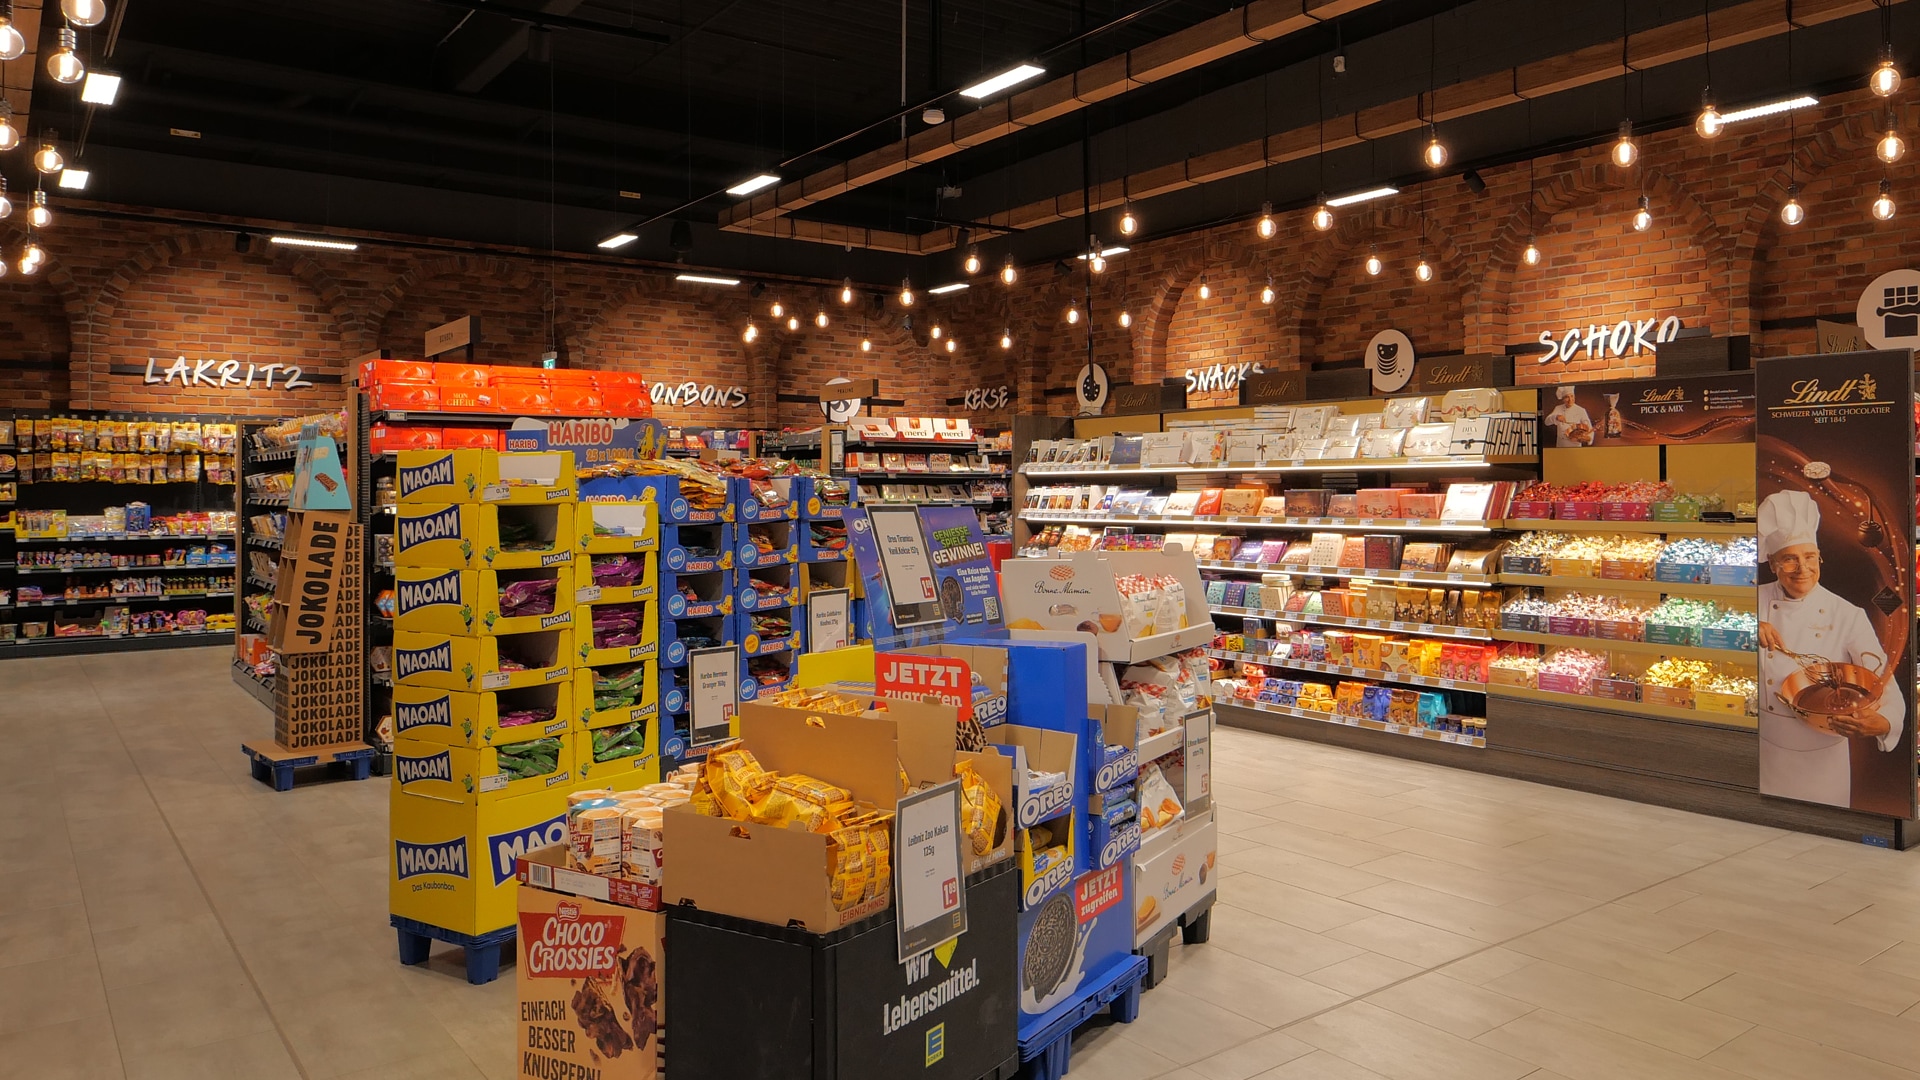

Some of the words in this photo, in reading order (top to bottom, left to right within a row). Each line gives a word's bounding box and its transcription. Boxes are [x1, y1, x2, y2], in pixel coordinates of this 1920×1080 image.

[1538, 315, 1680, 363] SCHOKO
[144, 356, 313, 390] LAKRITZ
[1426, 366, 1472, 386] Lindt
[650, 382, 747, 408] ONBONS
[1255, 381, 1290, 398] Lindt
[1640, 388, 1675, 402] Lindt
[1783, 378, 1859, 404] Lindt
[964, 385, 1009, 411] KEKSE
[1121, 393, 1149, 408] Lindt
[1640, 406, 1659, 414] PICK
[1660, 406, 1667, 414] &
[1667, 405, 1684, 413] MIX
[1771, 410, 1811, 418] SCHWEIZER
[1811, 408, 1837, 417] MAÎTRE
[1838, 406, 1890, 416] CHOCOLATIER
[1814, 416, 1828, 424] SEIT
[1830, 415, 1847, 423] 1845
[547, 421, 614, 446] HARIBO
[904, 429, 928, 437] merci
[941, 430, 964, 438] merci
[508, 439, 538, 449] HARIBO
[586, 449, 599, 462] 25
[402, 458, 451, 495] MAOAM
[547, 489, 569, 499] MAOAM
[673, 504, 686, 514] NEU
[689, 511, 716, 521] HARIBO
[745, 504, 756, 513] NEU
[760, 510, 781, 519] HARIBO
[822, 508, 842, 517] HARIBO
[401, 510, 458, 547] MAOAM
[853, 518, 871, 534] OR
[634, 538, 654, 547] MAOAM
[541, 550, 571, 566] MAOAM
[670, 553, 683, 563] NEU
[743, 549, 755, 558] NEU
[758, 555, 780, 565] HARIBO
[932, 541, 985, 565] GEWINNE!
[686, 561, 714, 571] HARIBO
[296, 521, 340, 645] JOKOLADE
[1034, 580, 1060, 595] Bonne
[1058, 581, 1092, 595] Maman
[400, 575, 457, 611] MAOAM
[632, 587, 653, 598] MAOAM
[743, 593, 755, 602] NEU
[670, 601, 683, 611] NEU
[758, 596, 782, 608] HARIBO
[687, 605, 713, 616] HARIBO
[541, 612, 571, 628] MAOAM
[630, 642, 655, 658] MAOAM
[670, 647, 683, 658] NEU
[760, 642, 785, 653] HARIBO
[291, 653, 361, 669] JOKOLADE
[398, 645, 449, 675] MAOAM
[291, 666, 361, 682] JOKOLADE
[546, 667, 568, 680] MAOAM
[883, 662, 962, 688] JETZT
[291, 679, 361, 696] JOKOLADE
[742, 685, 754, 694] NEU
[757, 686, 781, 697] HARIBO
[291, 692, 361, 708] JOKOLADE
[668, 695, 681, 706] NEU
[884, 689, 963, 708] zugrfen
[291, 704, 361, 722] JOKOLADE
[398, 700, 448, 729] MAOAM
[631, 704, 656, 719] MAOAM
[974, 696, 1007, 720] REO
[291, 717, 361, 735] JOKOLADE
[545, 721, 568, 734] MAOAM
[291, 730, 361, 748] JOKOLADE
[668, 743, 681, 754] NEU
[685, 745, 712, 759] HARIBO
[634, 754, 654, 767] MAOAM
[398, 755, 449, 783] MAOAM
[1097, 751, 1139, 790] OREO
[546, 772, 569, 786] MAOAM
[1020, 782, 1074, 828] OREO
[907, 832, 924, 847] Leibniz
[924, 830, 934, 841] Zoo
[934, 825, 949, 838] Kakao
[498, 821, 568, 876] MAO
[923, 845, 935, 857] 125g
[1101, 823, 1141, 868] OREO
[400, 844, 465, 875] MAOAM
[991, 848, 1006, 862] MINIS
[412, 883, 423, 892] Das
[423, 882, 456, 893] Kaubonbon.
[1026, 856, 1075, 907] OREO
[1080, 867, 1119, 901] JETZT
[1080, 887, 1118, 916] zugreifen
[839, 904, 868, 926] LEIBNIZ
[867, 897, 886, 914] MINIS
[543, 917, 605, 945] CHOCO
[529, 941, 615, 973] CROSSIES
[905, 950, 933, 986] Wir
[883, 958, 981, 1036] Lebensmittel.
[521, 1000, 566, 1022] EINFACH
[528, 1027, 576, 1053] BESSER
